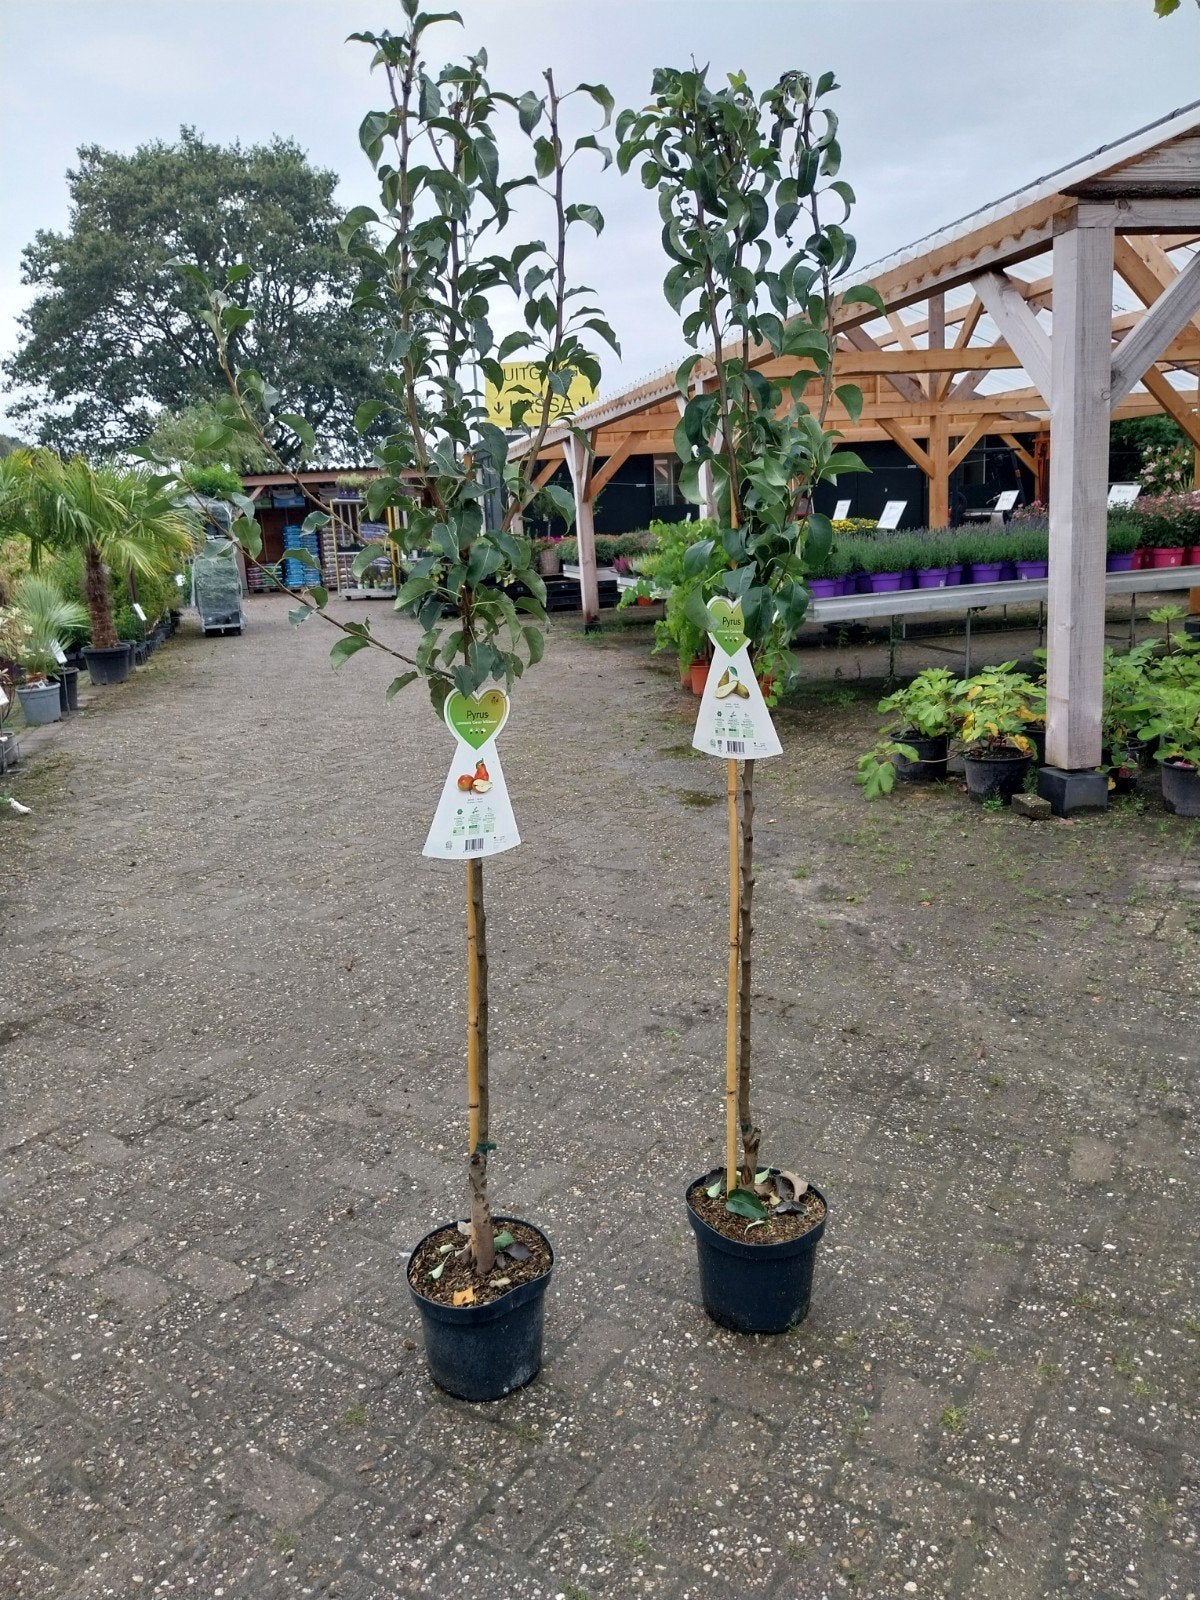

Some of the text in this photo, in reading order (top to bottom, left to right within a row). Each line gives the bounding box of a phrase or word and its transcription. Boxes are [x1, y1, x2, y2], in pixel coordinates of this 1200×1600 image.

[509, 394, 574, 413] SSA
[722, 616, 742, 628] Pyrus
[466, 710, 489, 721] Pyrus
